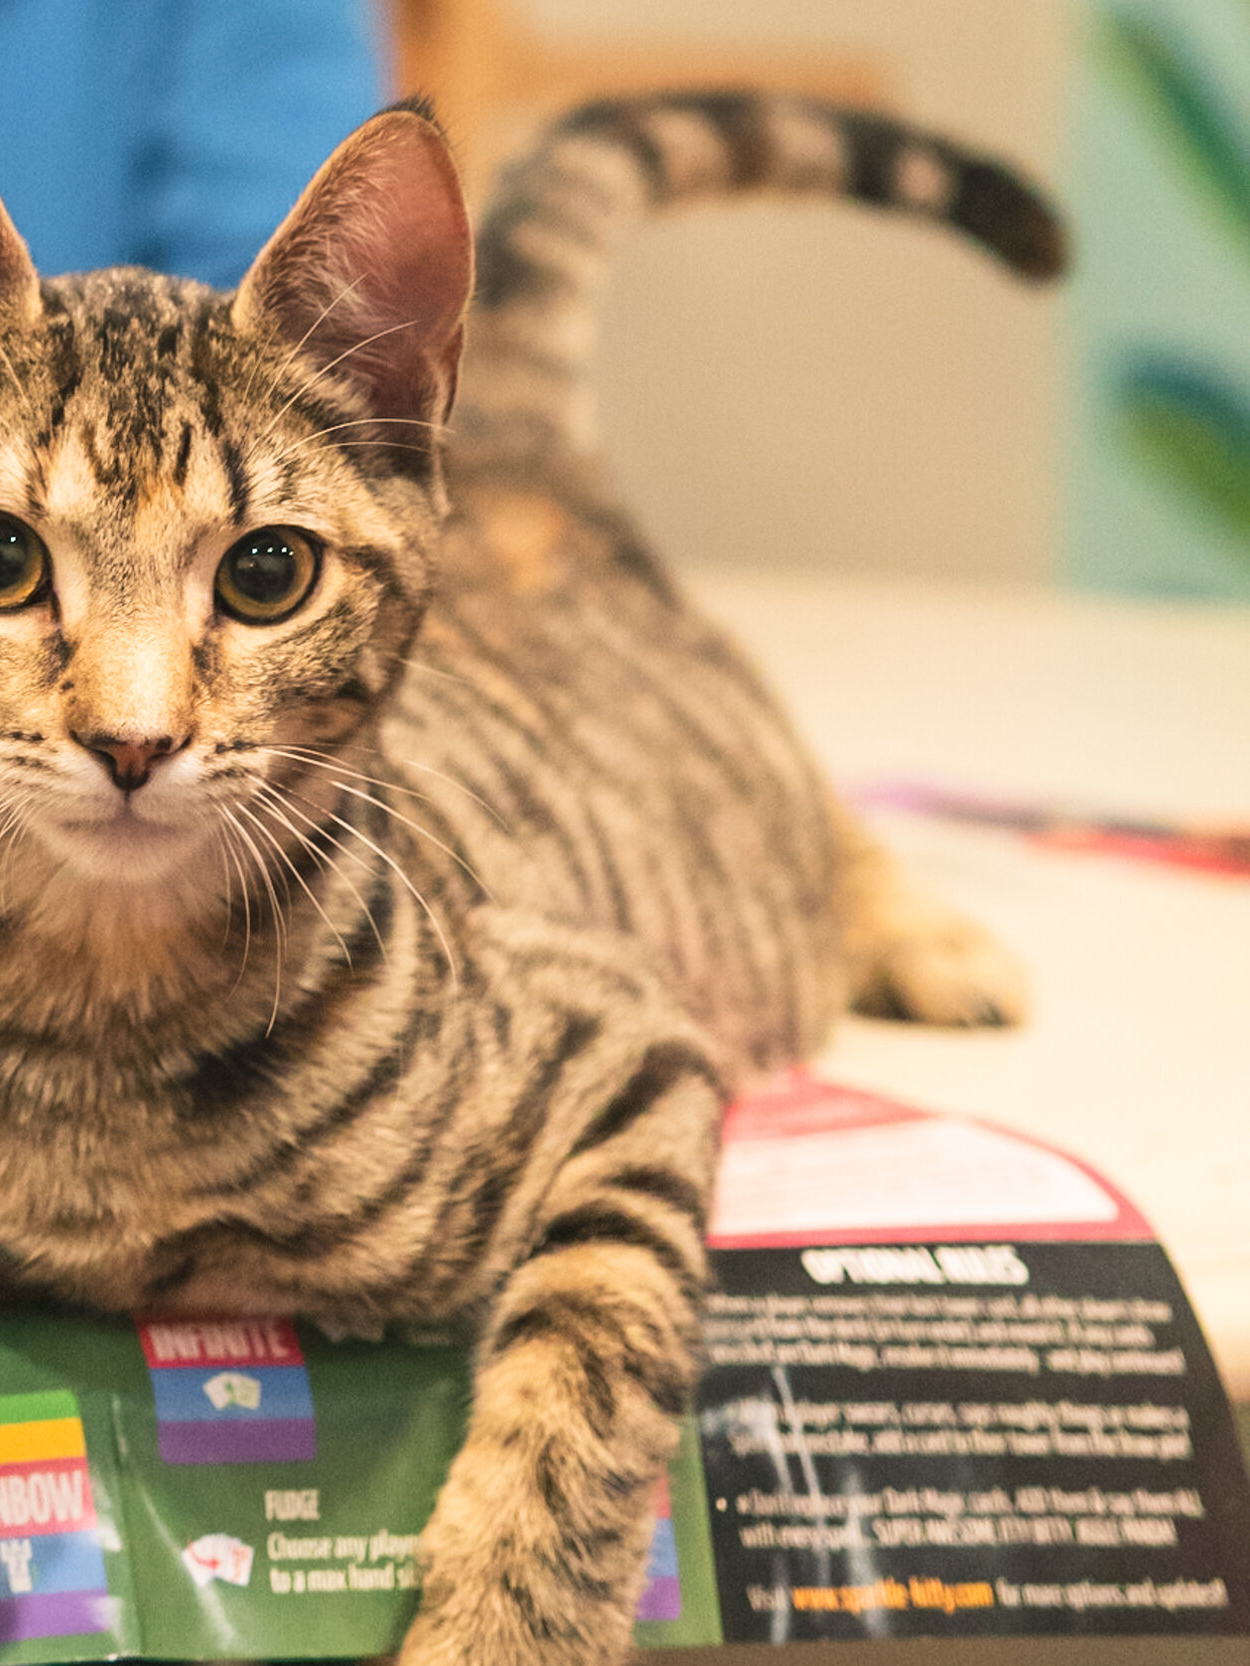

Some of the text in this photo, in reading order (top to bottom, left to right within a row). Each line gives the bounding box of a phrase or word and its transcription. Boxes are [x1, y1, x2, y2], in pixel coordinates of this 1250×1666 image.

[264, 1488, 321, 1522] FUDGE
[266, 1531, 332, 1561] Choose
[333, 1535, 368, 1564] any
[270, 1567, 292, 1595] to
[293, 1570, 306, 1594] a
[307, 1568, 349, 1593] max
[348, 1561, 395, 1592] hand
